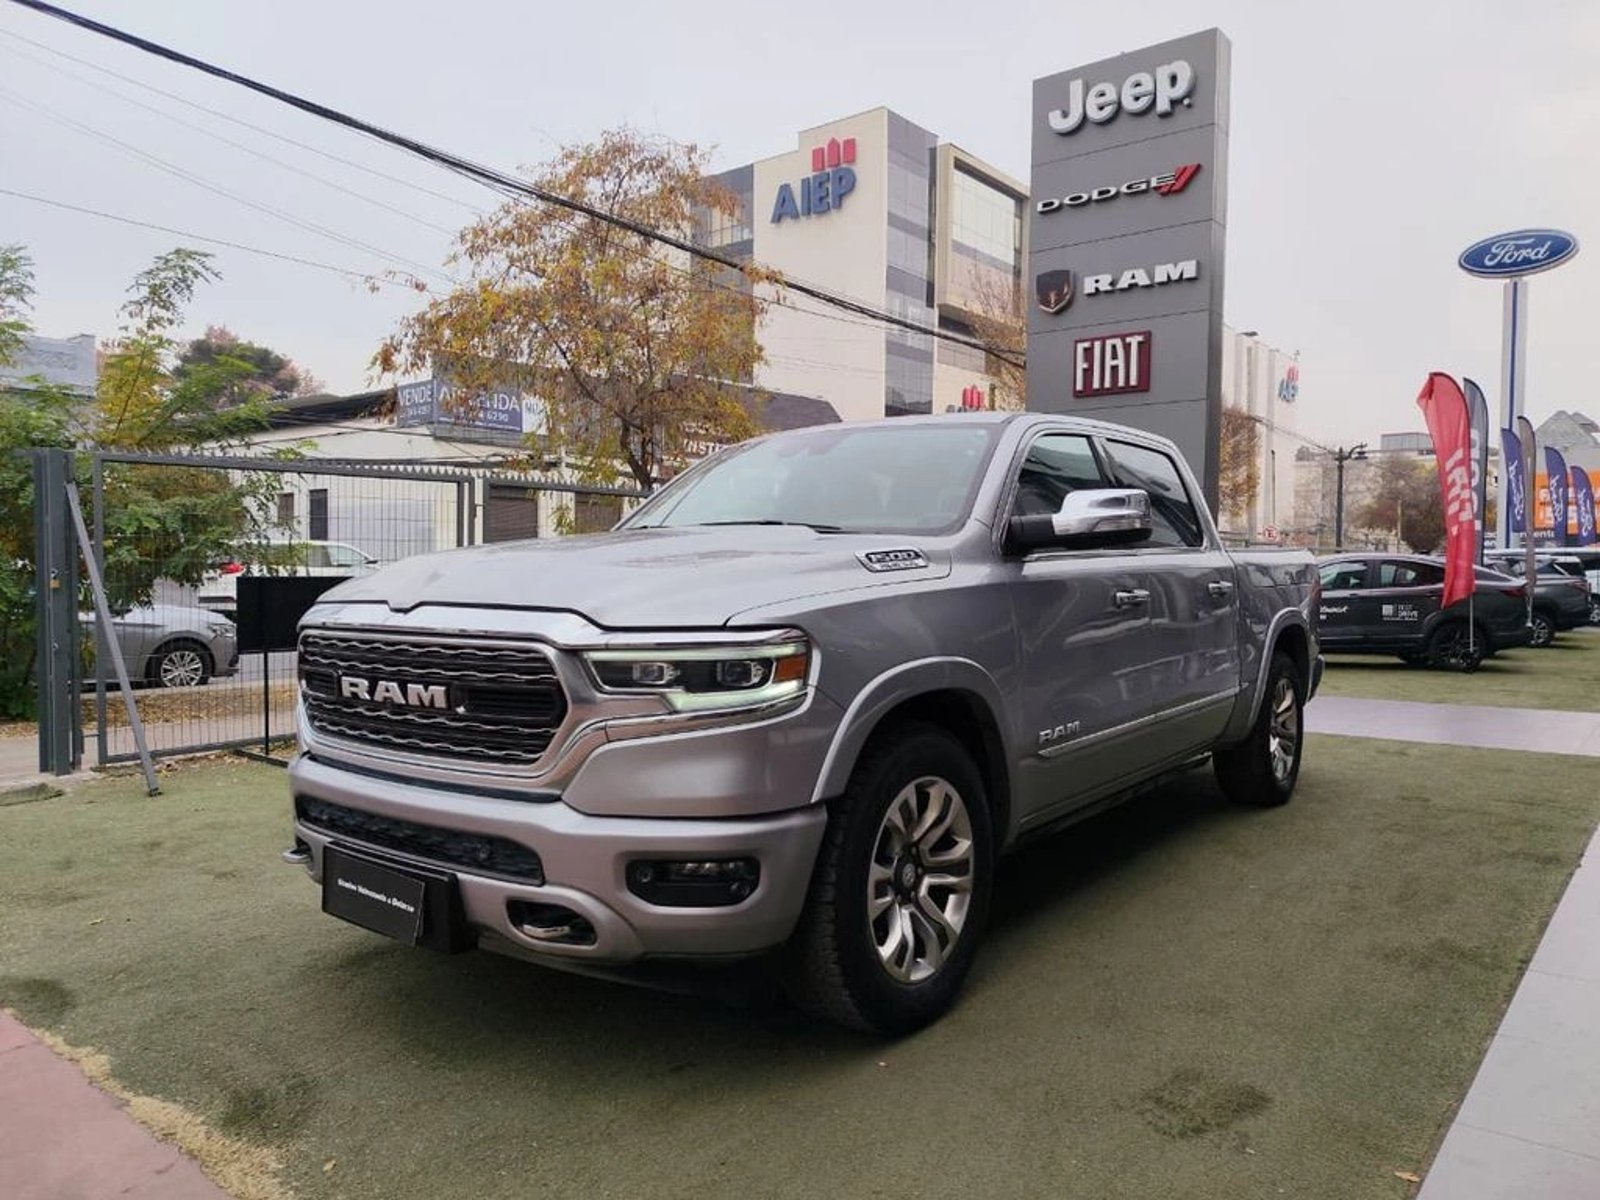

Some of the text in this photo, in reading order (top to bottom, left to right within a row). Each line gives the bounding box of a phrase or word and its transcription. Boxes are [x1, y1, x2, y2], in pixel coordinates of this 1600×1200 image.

[1049, 60, 1194, 134] Jeep
[771, 166, 857, 223] AIEP
[1037, 173, 1177, 213] DODGE
[1484, 238, 1553, 266] Ford
[1083, 259, 1198, 296] RAM
[1075, 335, 1145, 392] FIAT
[399, 385, 432, 407] VENDE
[340, 675, 448, 709] RAM
[1039, 720, 1080, 744] RAM
